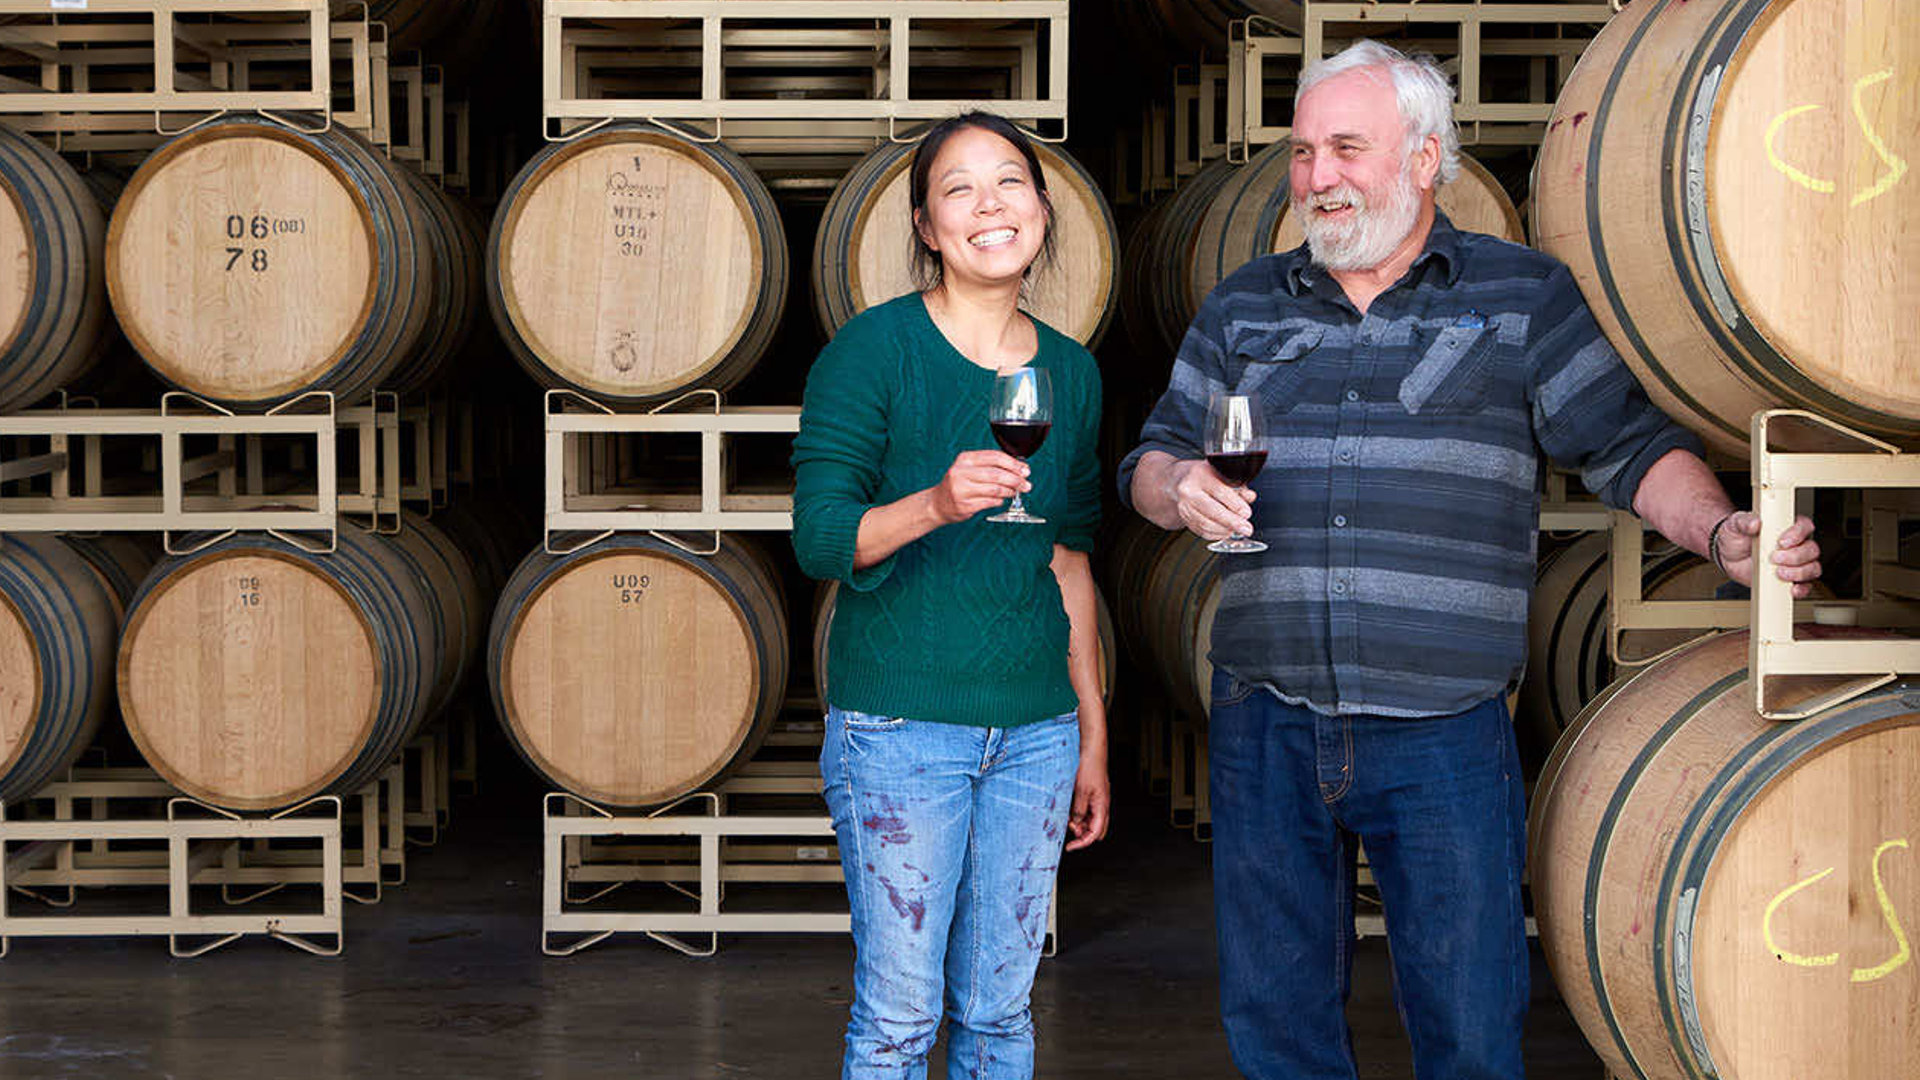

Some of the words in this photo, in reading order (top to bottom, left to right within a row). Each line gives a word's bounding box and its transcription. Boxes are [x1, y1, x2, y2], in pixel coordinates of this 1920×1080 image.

[1764, 67, 1909, 207] CS
[225, 247, 268, 272] 78
[613, 574, 650, 588] U09
[622, 589, 643, 604] 57
[1763, 838, 1911, 983] CS
